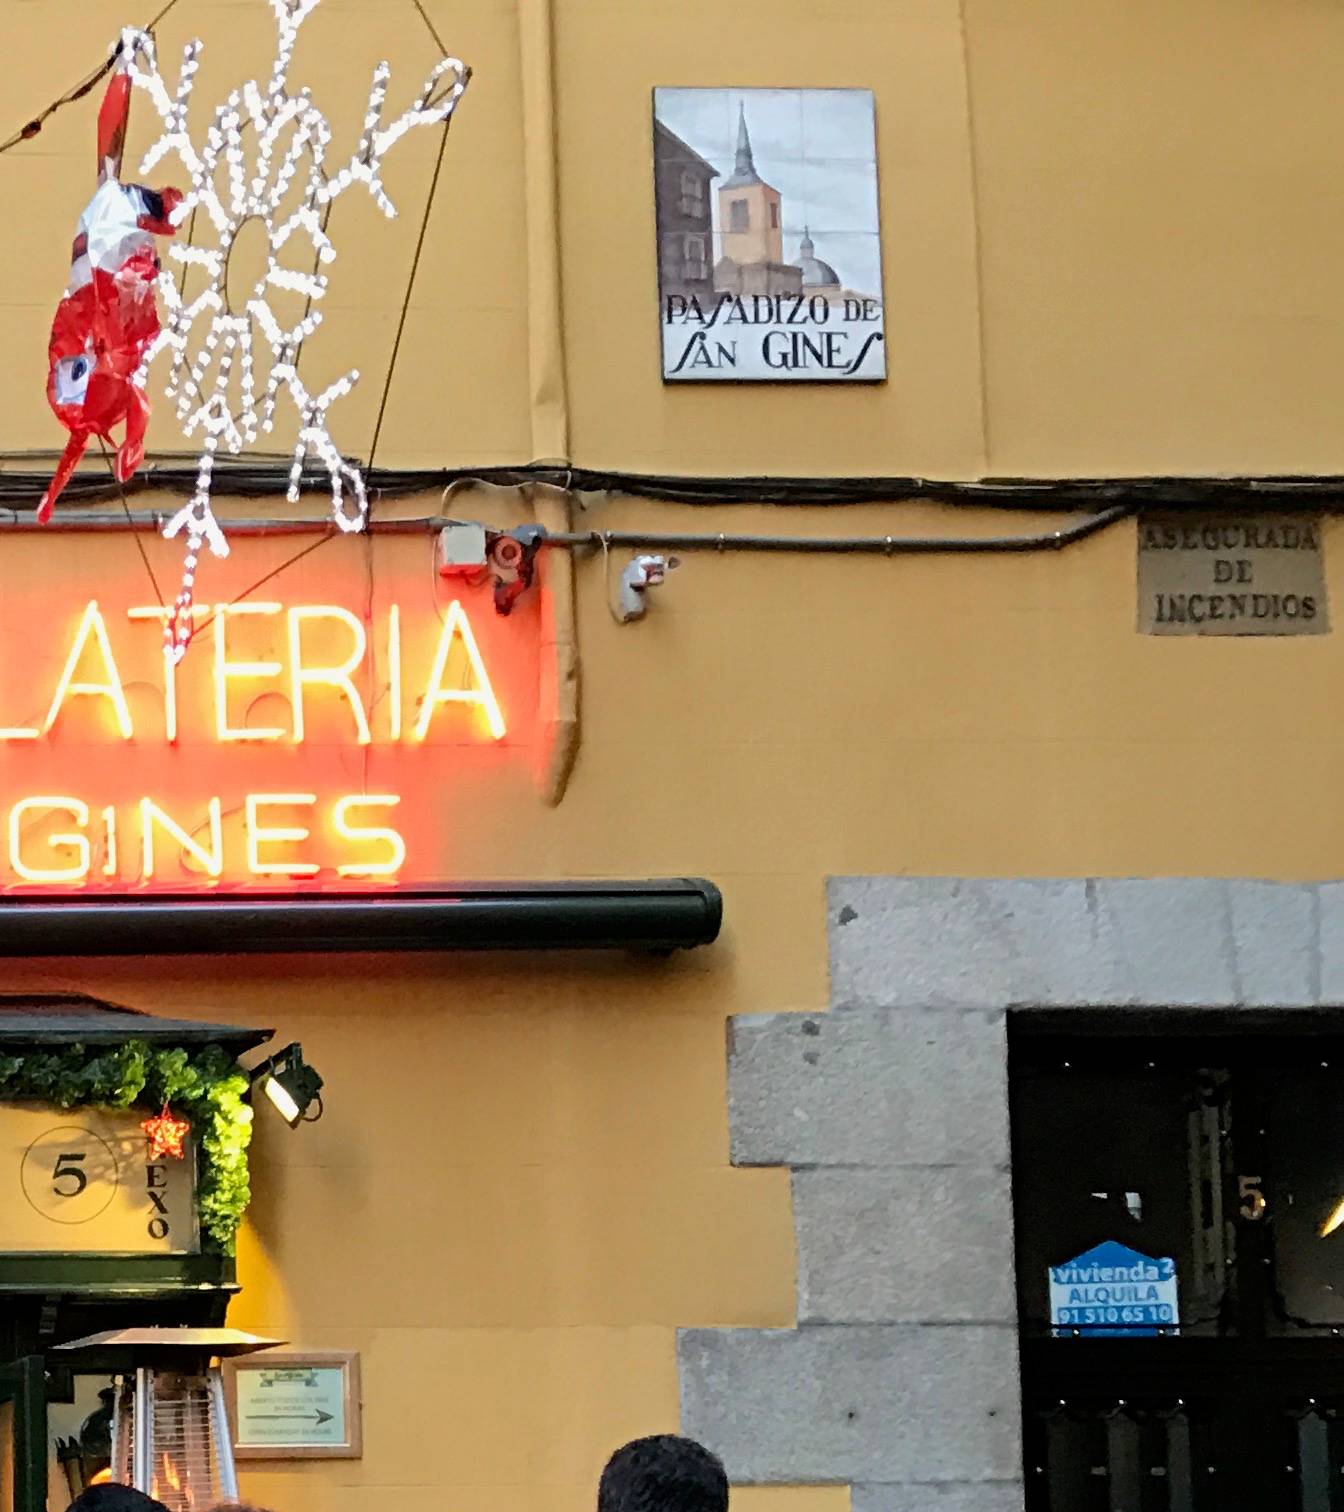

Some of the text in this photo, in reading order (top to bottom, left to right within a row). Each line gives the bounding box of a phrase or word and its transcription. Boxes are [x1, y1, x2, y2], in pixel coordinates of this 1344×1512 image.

[666, 293, 881, 329] PASADIZO DE
[669, 331, 883, 374] SAN GINES
[1144, 524, 1318, 551] ASEGURADA
[1213, 559, 1254, 584] DE
[1155, 593, 1317, 623] INCENDIOS
[7, 792, 407, 882] GINES
[52, 1153, 87, 1198] 5
[1237, 1174, 1266, 1221] 5
[1069, 1285, 1159, 1304] ALQUILA
[1058, 1305, 1171, 1324] 91 510 65 10
